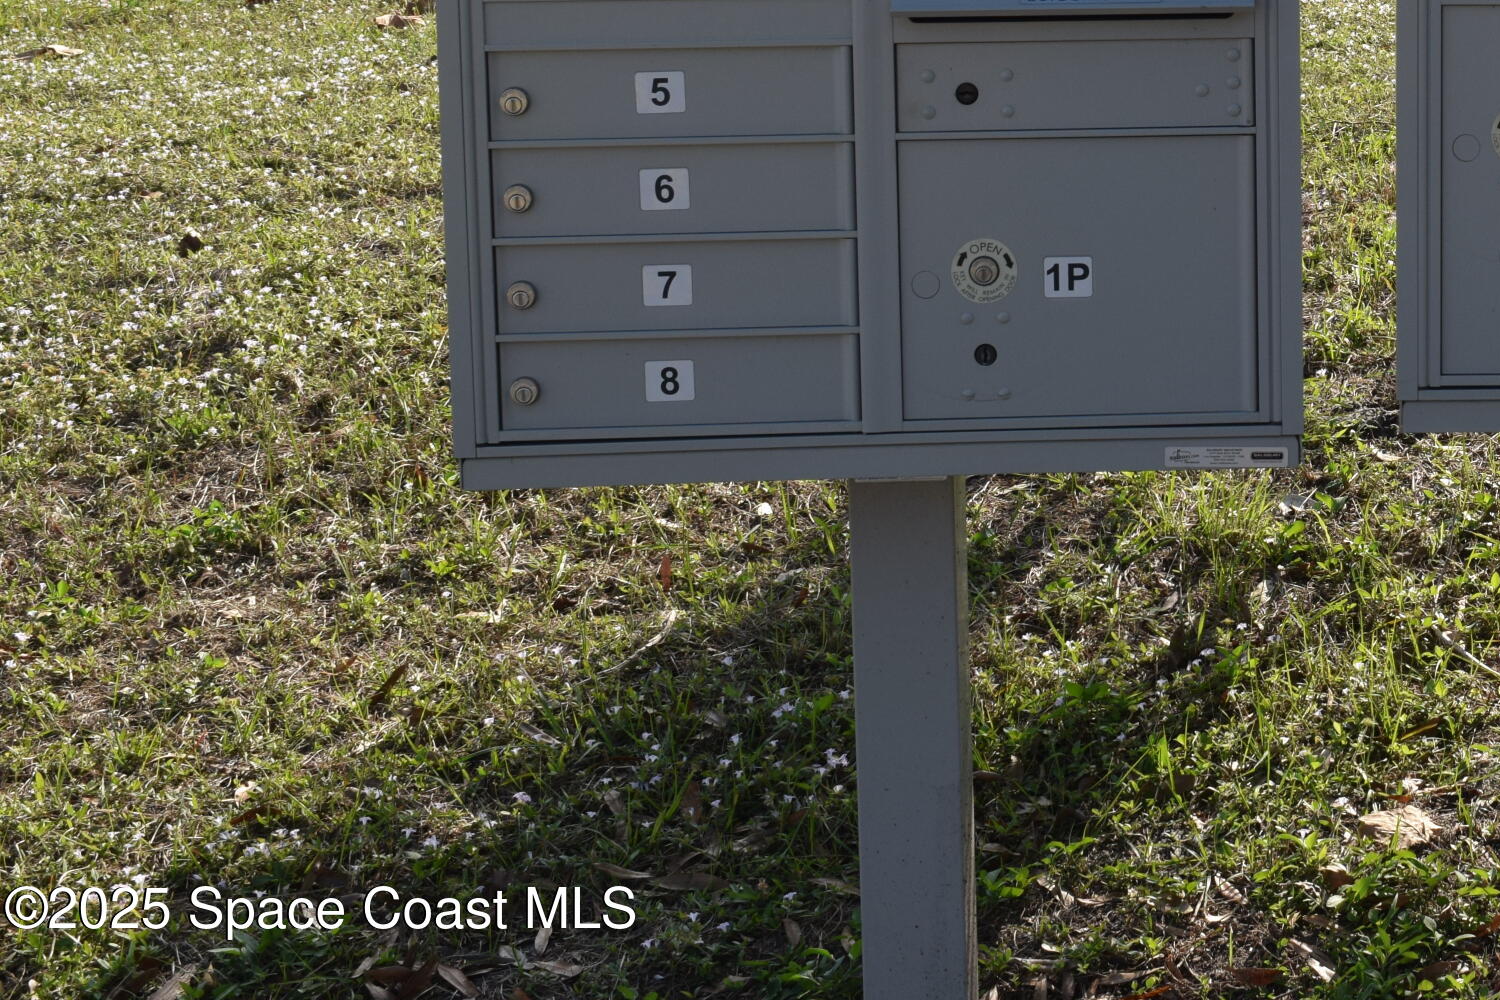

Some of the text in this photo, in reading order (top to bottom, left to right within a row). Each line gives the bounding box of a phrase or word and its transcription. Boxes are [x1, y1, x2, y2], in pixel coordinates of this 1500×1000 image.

[651, 77, 671, 107] 5
[654, 174, 675, 204] 6
[969, 242, 1003, 256] OPEN
[657, 270, 677, 299] 7
[1045, 262, 1091, 292] 1P
[660, 366, 680, 396] 8
